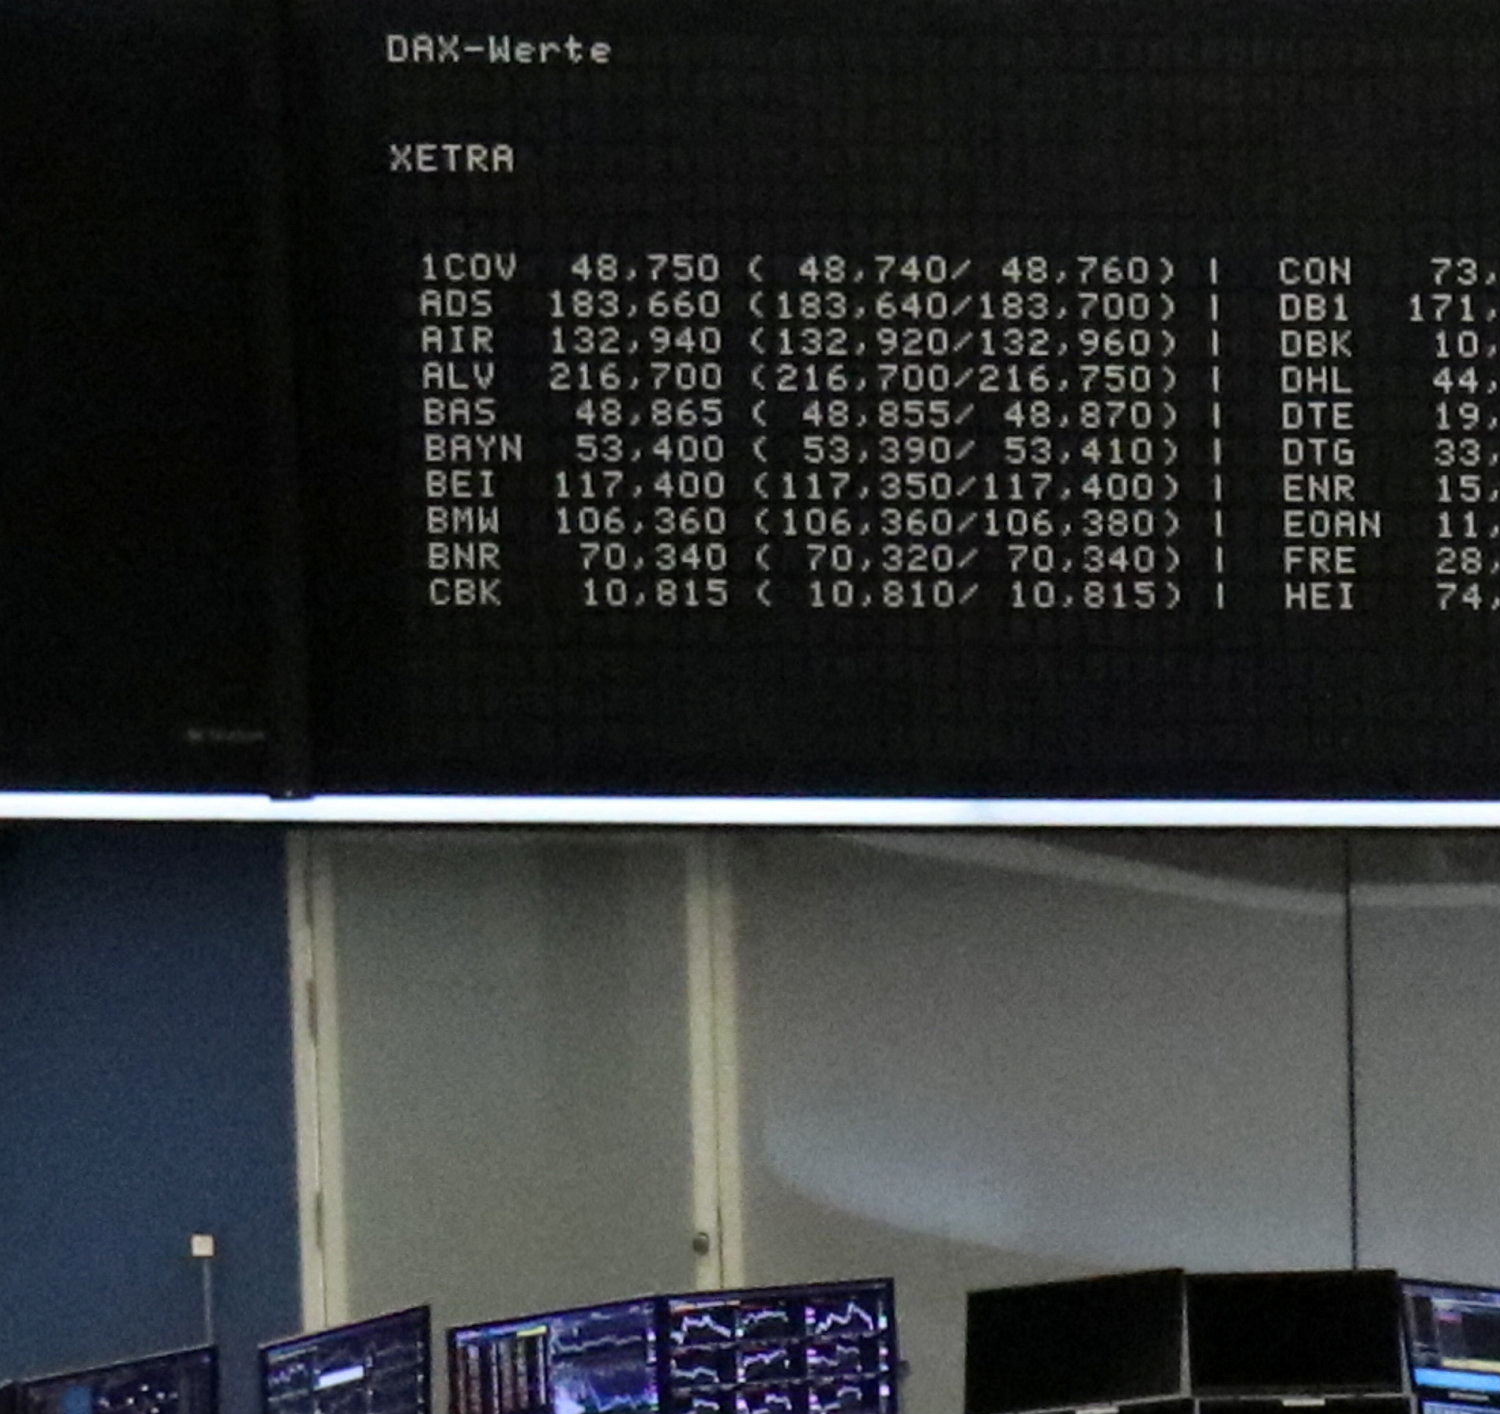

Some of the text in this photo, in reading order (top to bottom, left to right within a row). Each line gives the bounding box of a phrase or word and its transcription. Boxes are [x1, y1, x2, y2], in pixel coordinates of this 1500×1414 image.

[387, 34, 611, 64] DAX-Werte
[390, 143, 514, 172] XETRA
[423, 252, 719, 282] 1COV 48,750
[1279, 256, 1351, 286] CON
[420, 289, 492, 318] ADS
[551, 289, 720, 318] 183,660
[1279, 292, 1348, 322] DB1
[421, 325, 493, 354] AIR
[552, 325, 722, 355] 132,940
[1280, 329, 1352, 358] DBK
[422, 361, 495, 390] ALV
[549, 361, 722, 391] 216,700
[1281, 365, 1352, 394] DHL
[423, 397, 723, 427] BAS 48,865
[1282, 401, 1353, 431] DTE
[424, 433, 724, 463] BAYN 53,400
[1282, 437, 1355, 467] DTG
[425, 469, 493, 498] BEI
[556, 470, 725, 499] 117,400
[1283, 473, 1355, 503] ENR
[427, 505, 499, 534] BMW
[557, 506, 726, 535] 106,360
[1284, 509, 1381, 539] EOAN
[428, 541, 727, 571] BNR 70,340
[1284, 545, 1356, 574] FRE
[429, 577, 728, 607] CBK 10,815
[1285, 581, 1353, 610] HEI
